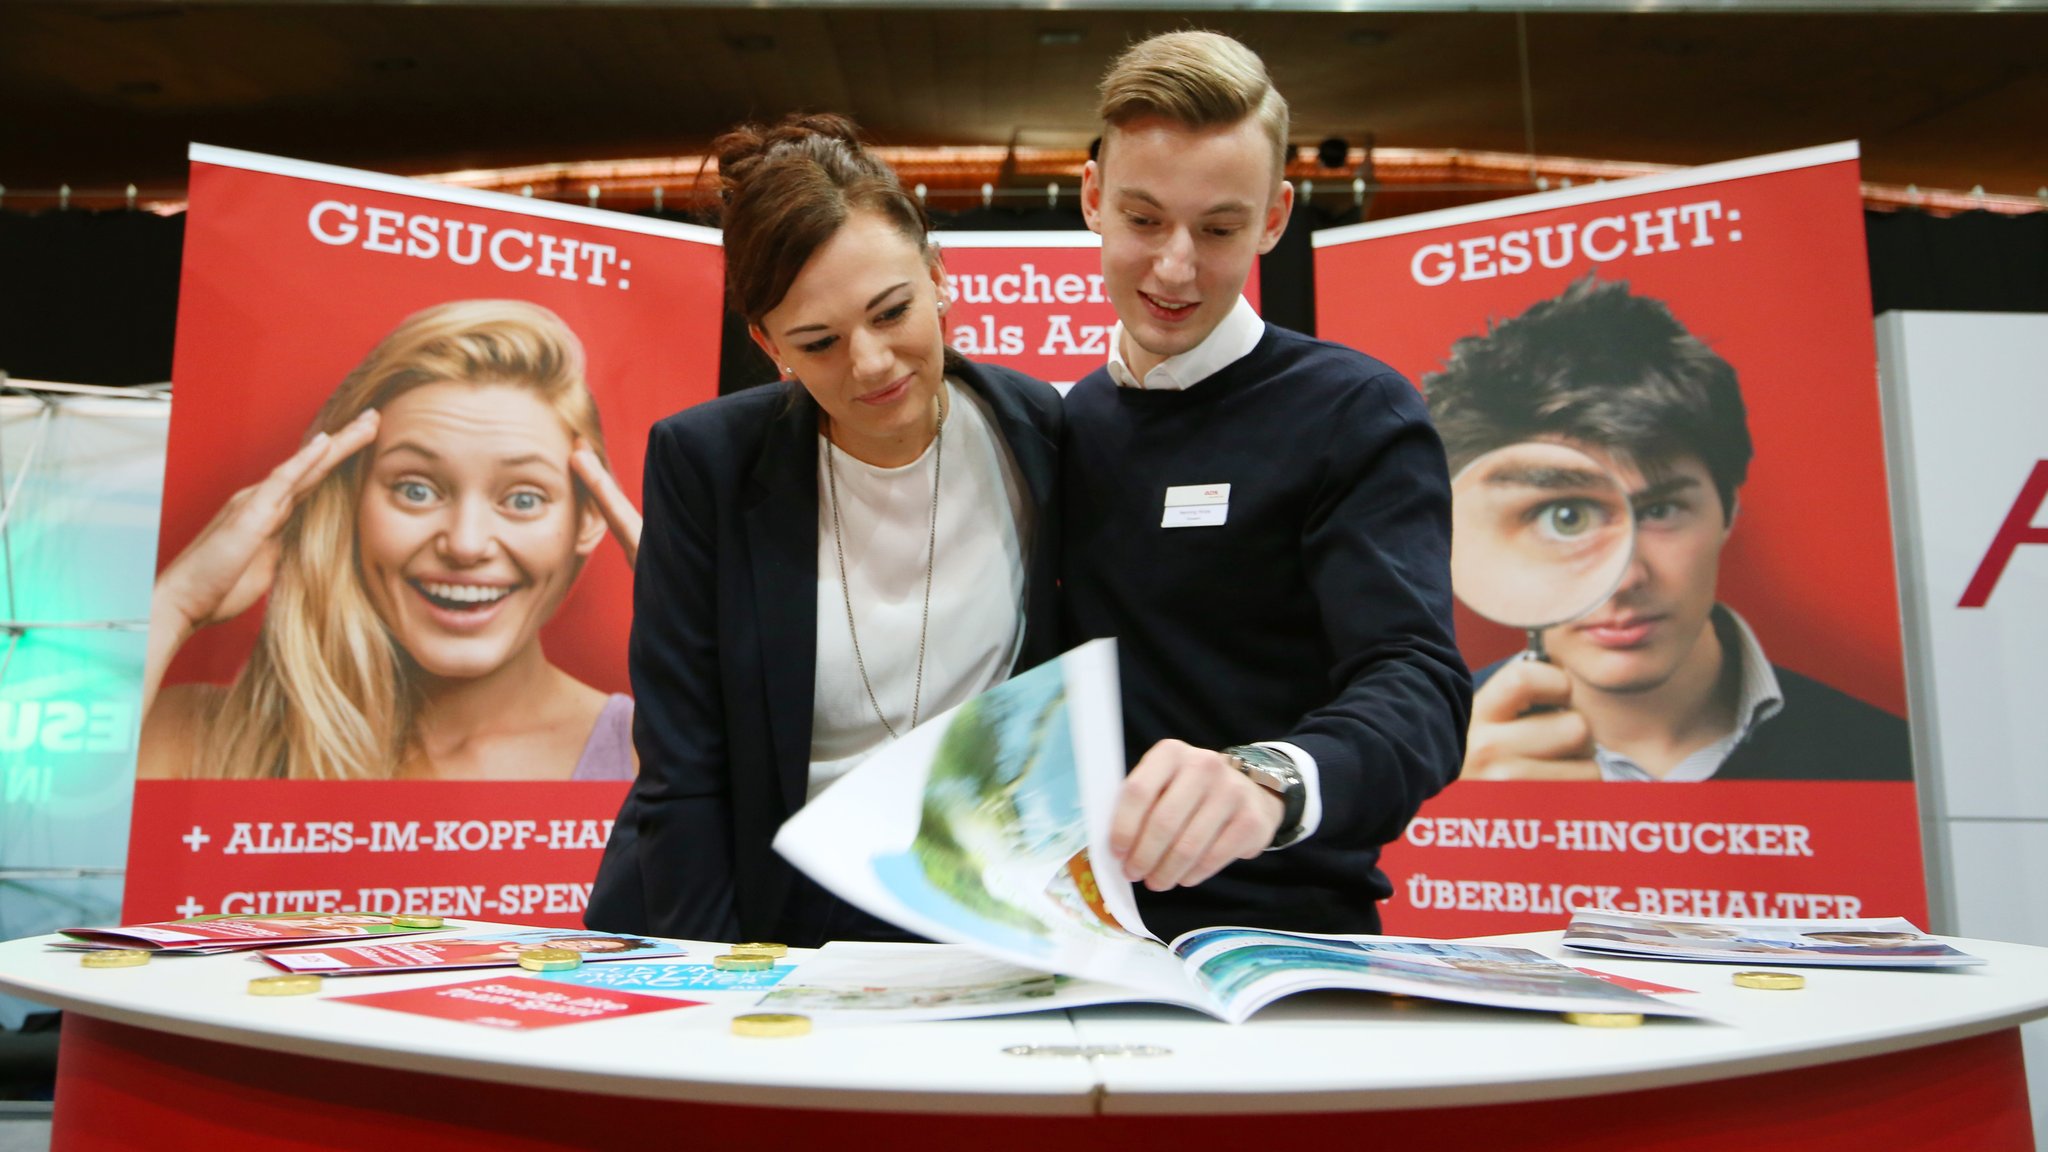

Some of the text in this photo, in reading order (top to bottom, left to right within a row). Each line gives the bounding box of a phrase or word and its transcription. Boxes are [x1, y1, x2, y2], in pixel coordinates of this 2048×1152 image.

[308, 200, 631, 290] GESUCHT:
[1410, 200, 1742, 287] GESUCHT:
[953, 314, 1025, 356] als
[1405, 816, 1814, 857] GENAU-HINGUCKER
[1406, 873, 1862, 919] ÜBERBLICK-BEHALTER
